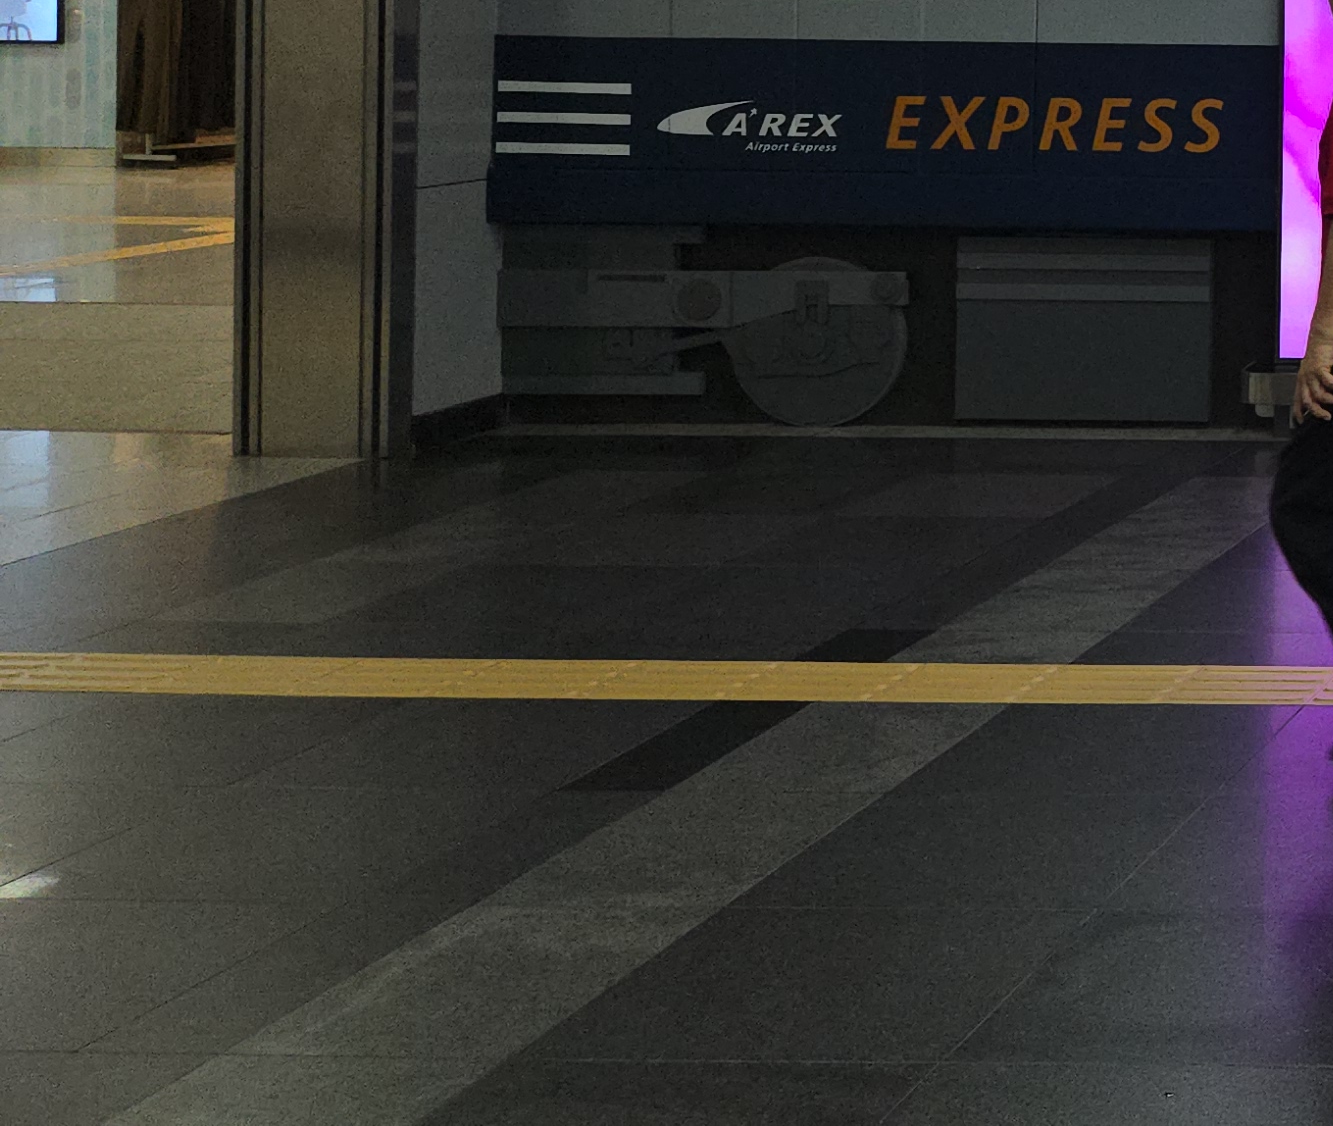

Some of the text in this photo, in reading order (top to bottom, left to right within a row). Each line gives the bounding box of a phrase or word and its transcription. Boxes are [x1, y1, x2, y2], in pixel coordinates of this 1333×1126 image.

[886, 94, 1225, 153] EXPRESS
[745, 142, 837, 154] Airport Express
